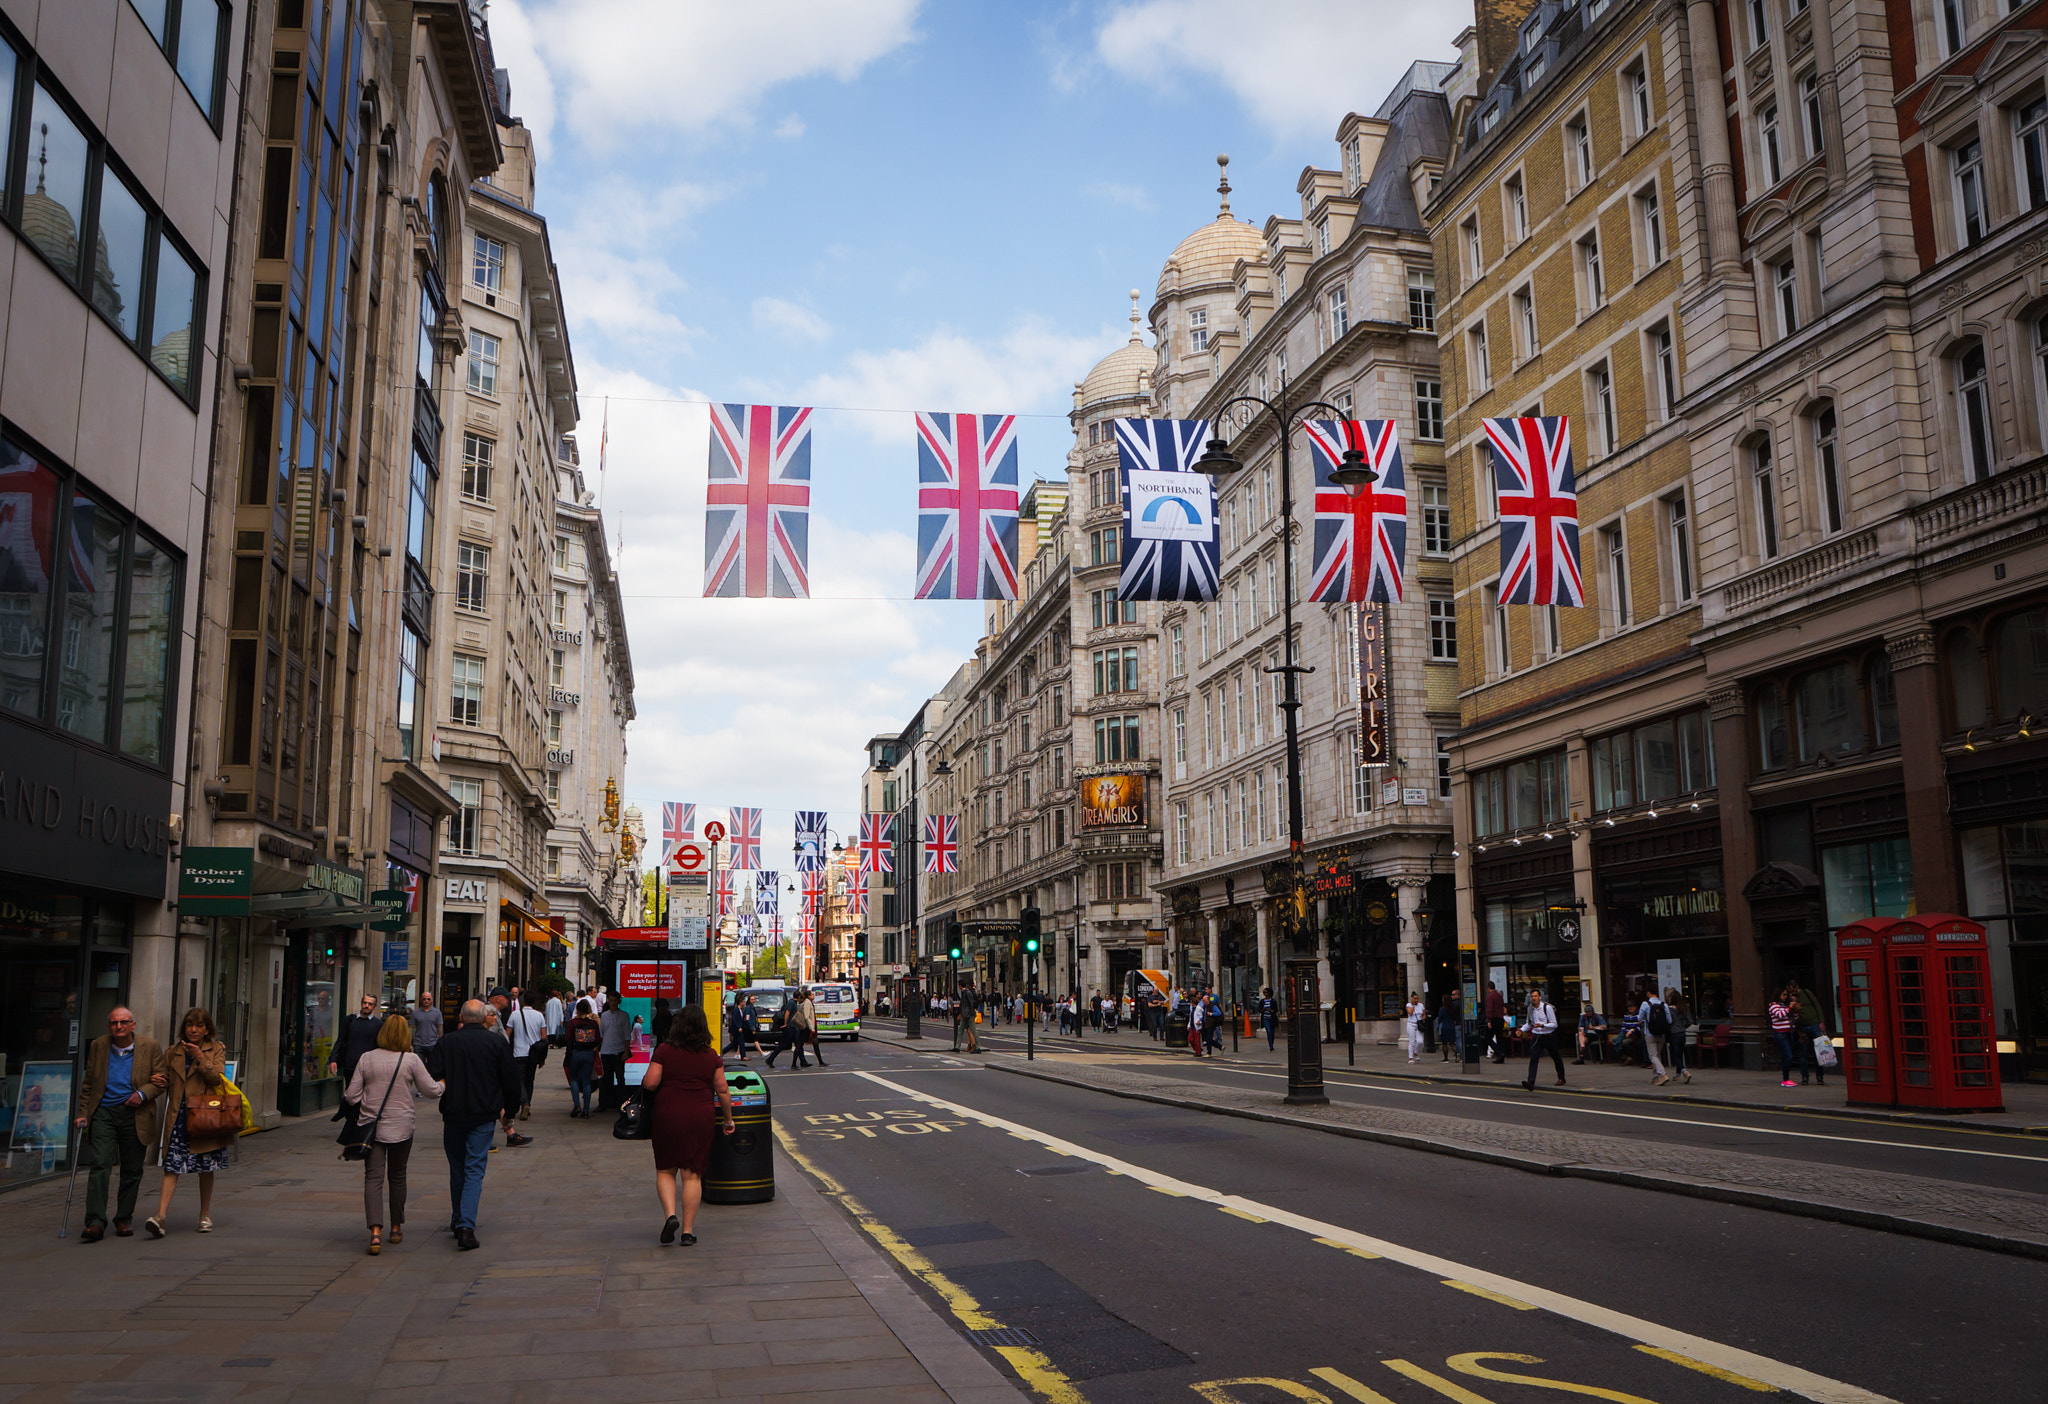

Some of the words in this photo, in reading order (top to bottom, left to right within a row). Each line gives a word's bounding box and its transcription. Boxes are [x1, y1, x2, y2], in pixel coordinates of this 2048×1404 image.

[1138, 483, 1203, 496] NORTHBANK
[550, 628, 583, 645] rand
[549, 685, 581, 705] lace
[547, 749, 574, 765] otel
[1105, 762, 1152, 773] THEATRE
[1083, 805, 1138, 826] DREAMGIRLS
[79, 795, 169, 857] HOUSE
[709, 826, 721, 837] A
[185, 868, 246, 876] Robert
[193, 876, 235, 885] Dyas
[1316, 878, 1334, 891] COAL
[1335, 874, 1352, 888] HOLE
[446, 879, 488, 901] EAT.
[374, 900, 403, 908] HOLLAND
[1654, 895, 1674, 917] PRET
[1676, 896, 1683, 916] A
[2, 902, 50, 923] Dyas
[1842, 938, 1872, 946] TELEPHONE
[1891, 934, 1924, 942] TELEPHONE
[1937, 933, 1979, 941] TELEPHONE
[803, 1109, 927, 1125] BUS
[801, 1120, 968, 1141] STOP
